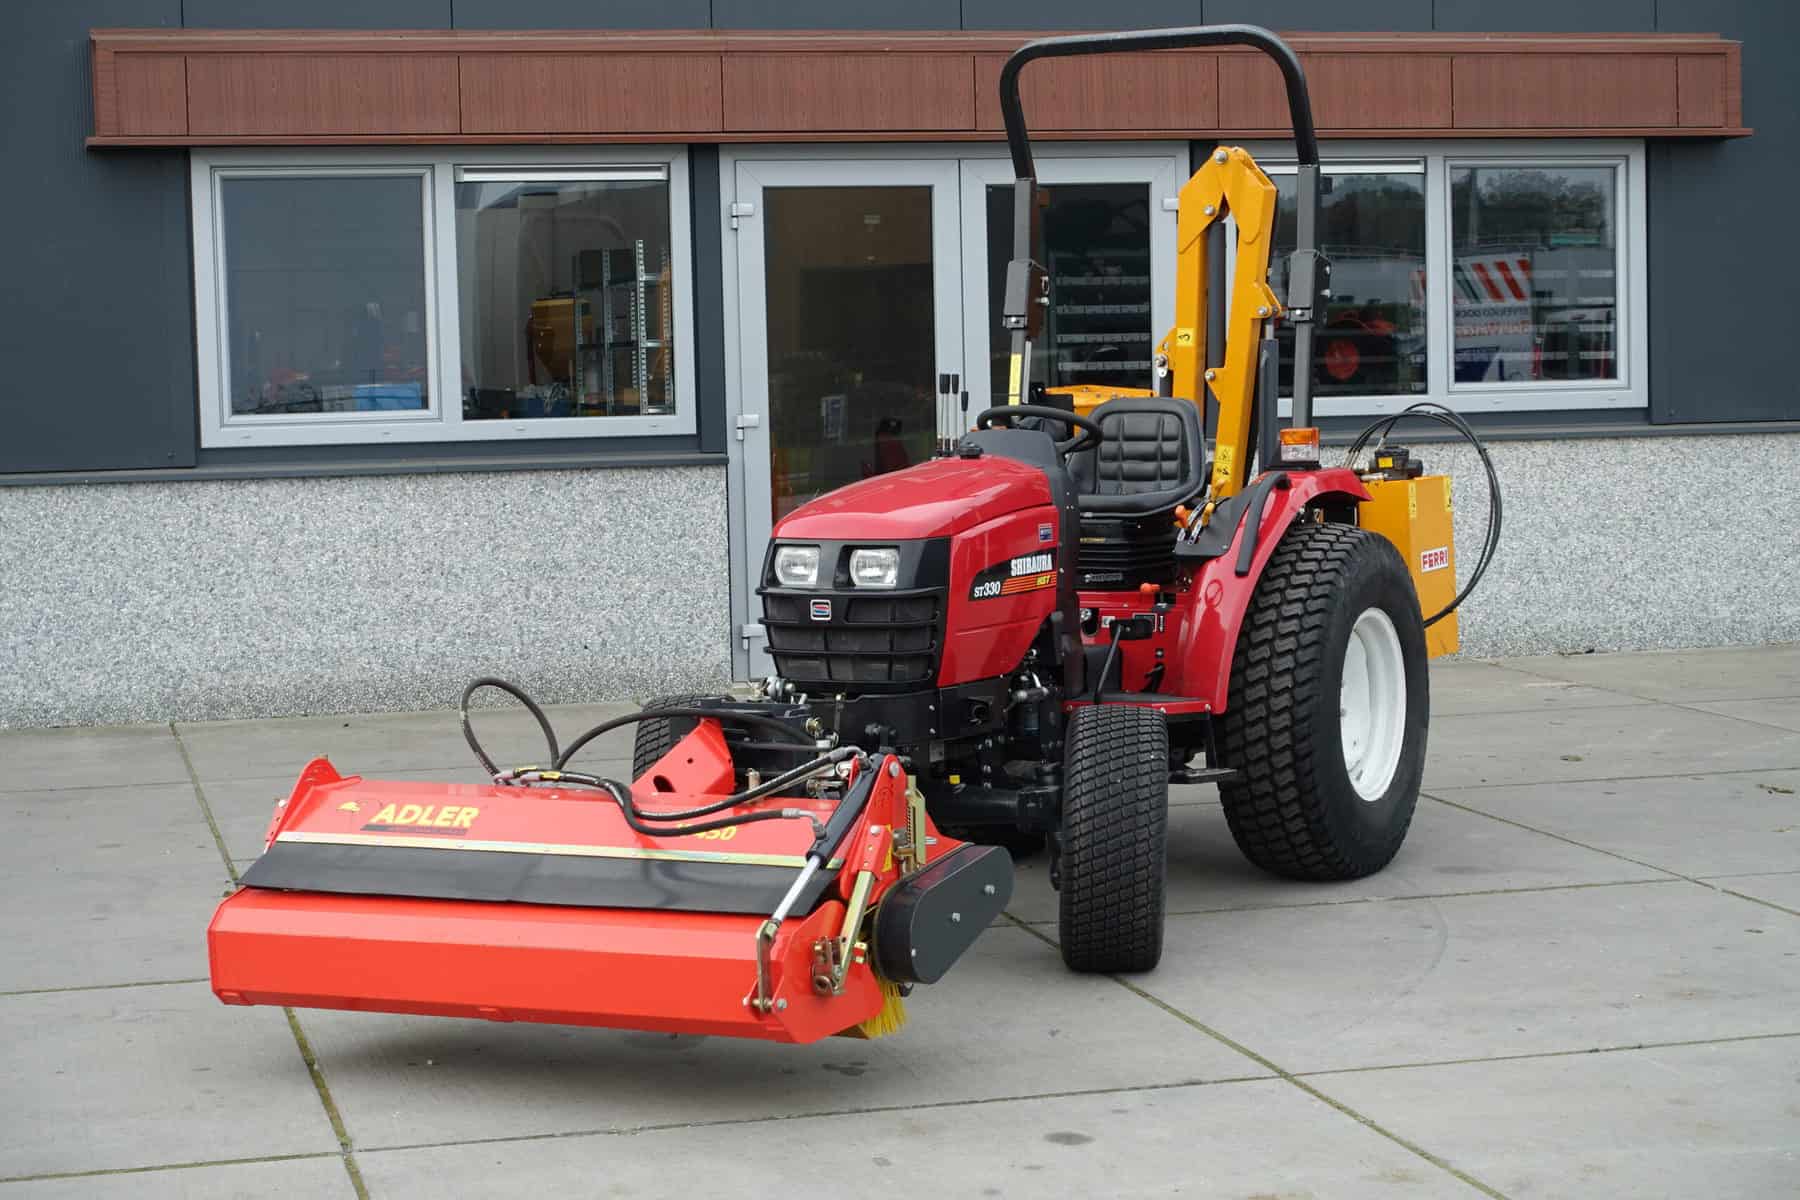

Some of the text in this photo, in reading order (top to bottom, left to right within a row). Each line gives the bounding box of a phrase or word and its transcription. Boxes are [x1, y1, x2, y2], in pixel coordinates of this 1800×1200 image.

[1010, 553, 1053, 577] SHIBAURA
[1422, 549, 1448, 569] FERRI
[974, 581, 1001, 598] ST330
[369, 803, 480, 828] ADLER
